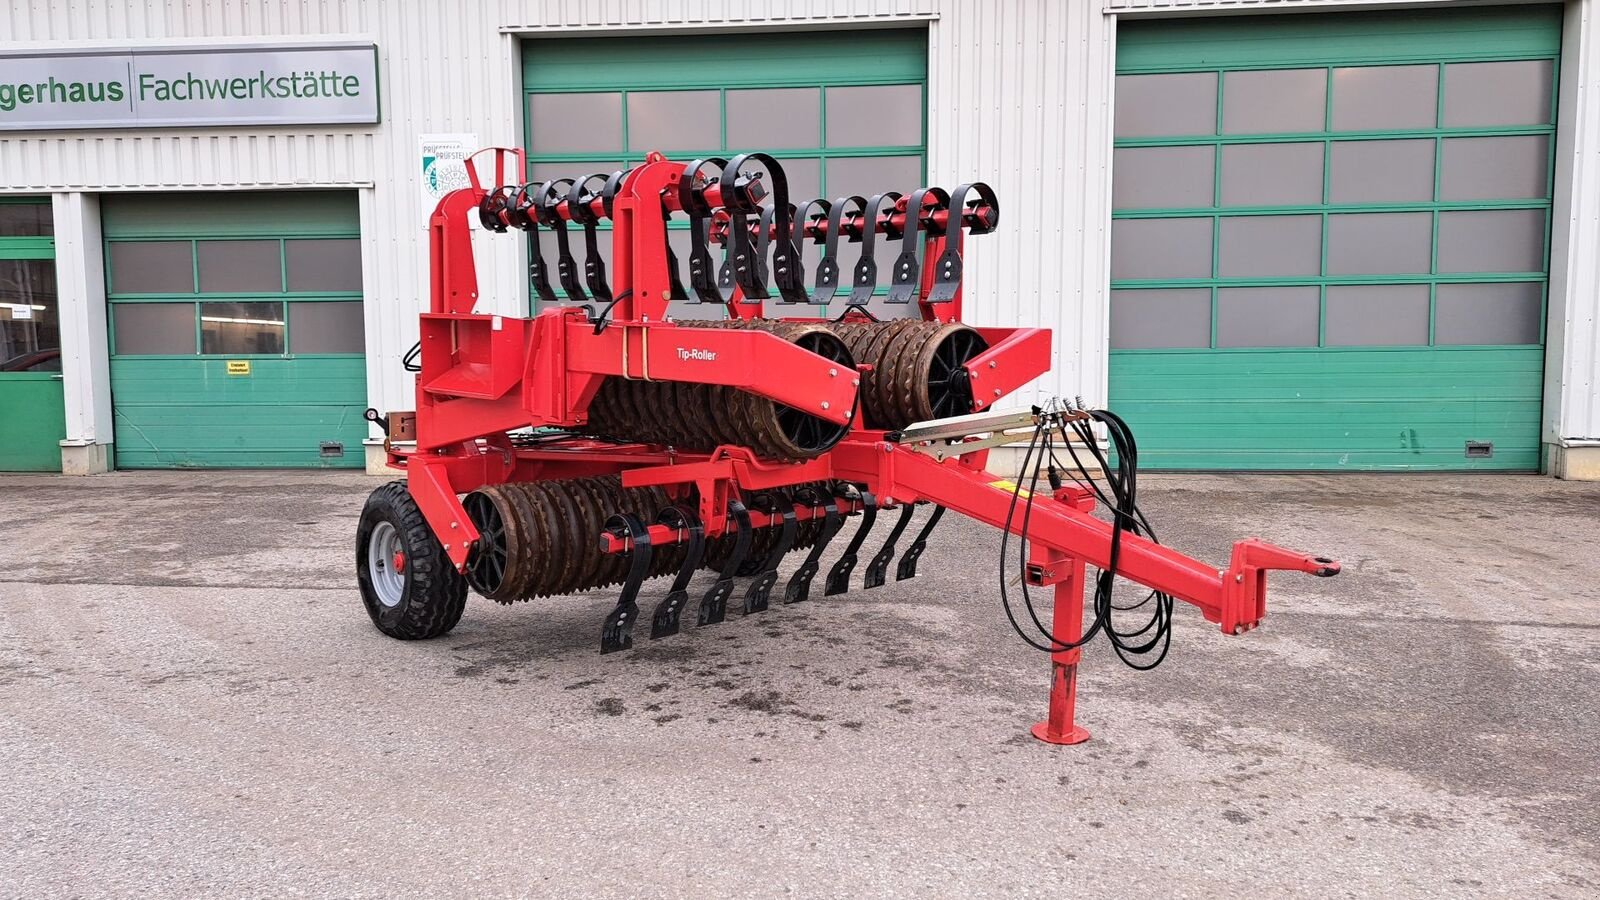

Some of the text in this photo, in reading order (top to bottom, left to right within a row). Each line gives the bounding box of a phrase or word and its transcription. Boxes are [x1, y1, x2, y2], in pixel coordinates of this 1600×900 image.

[0, 70, 360, 111] gerhaus Fachwerkstätte
[677, 348, 716, 361] Tip-Roller
